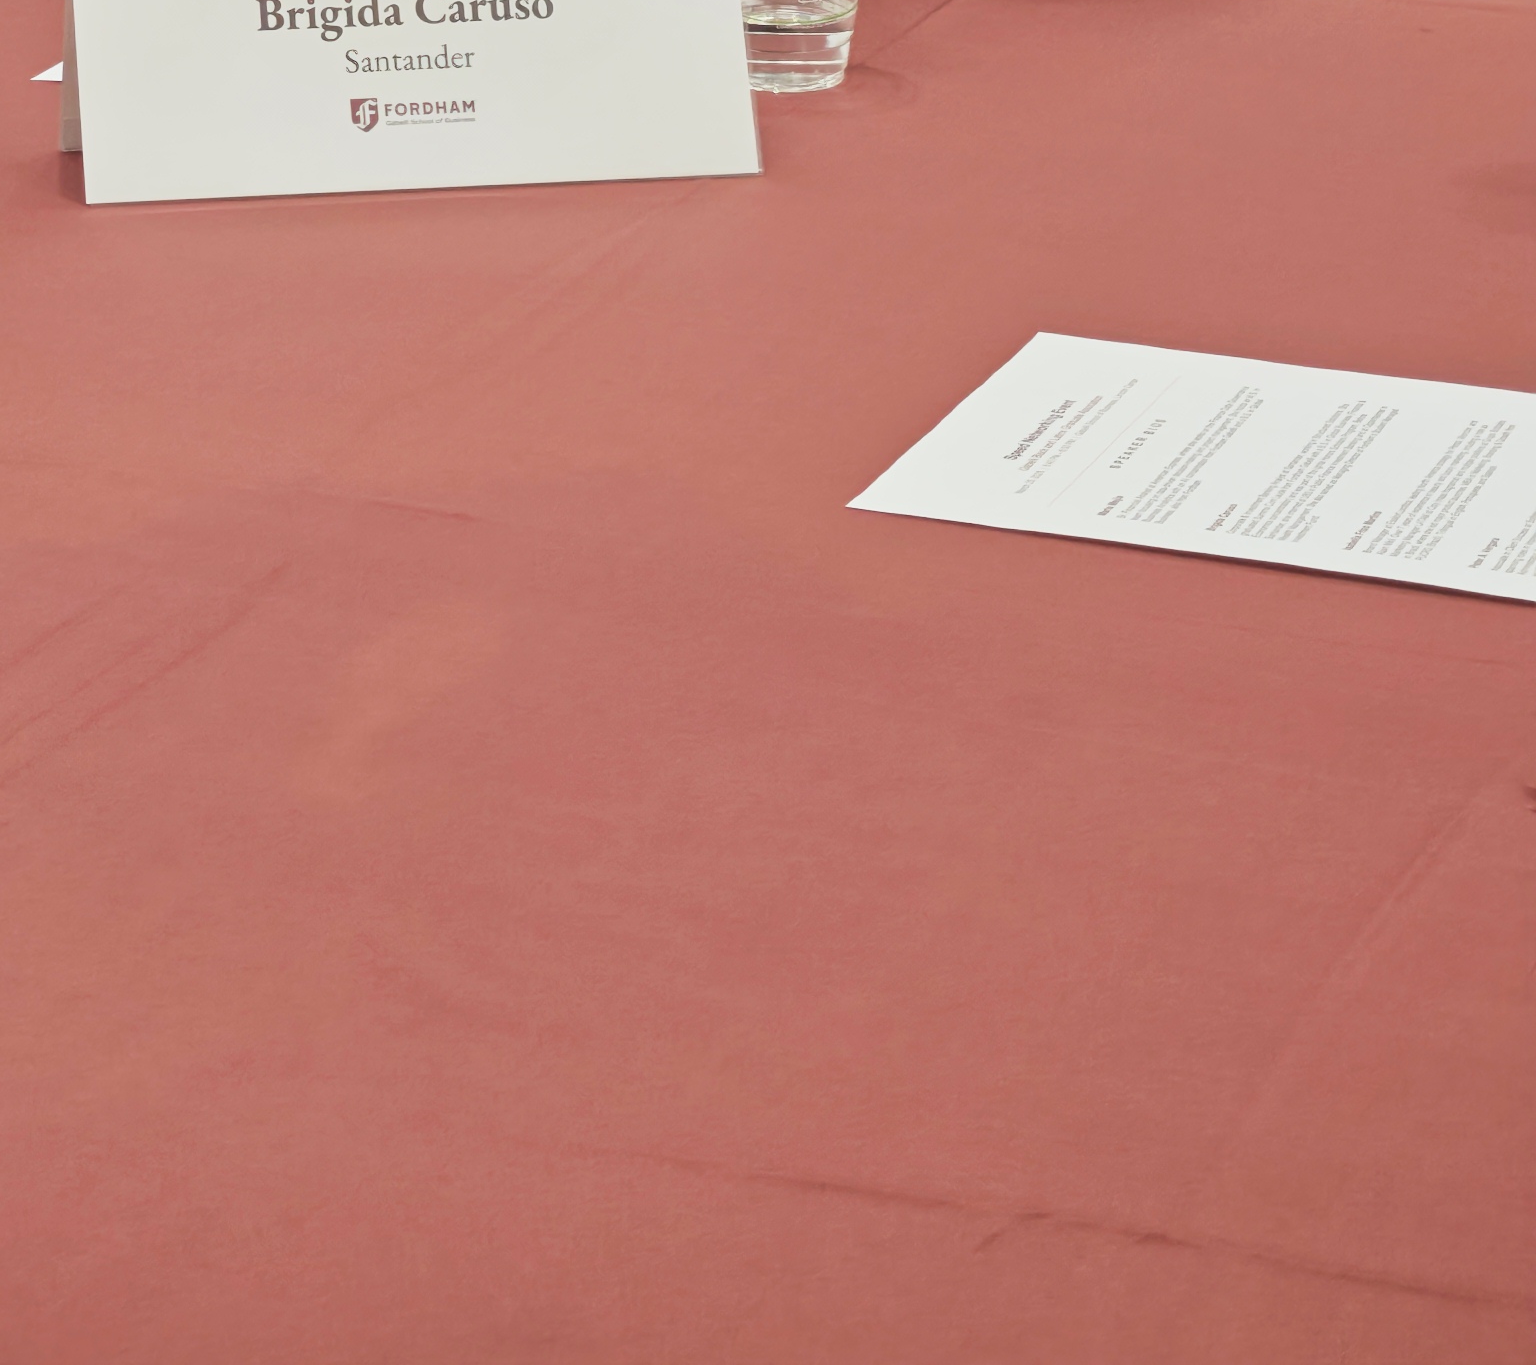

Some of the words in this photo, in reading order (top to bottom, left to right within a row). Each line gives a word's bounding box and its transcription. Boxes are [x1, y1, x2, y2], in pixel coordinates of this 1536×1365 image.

[345, 44, 475, 74] Santander
[384, 100, 476, 117] FORDHAM
[1109, 437, 1148, 469] SPEAKER
